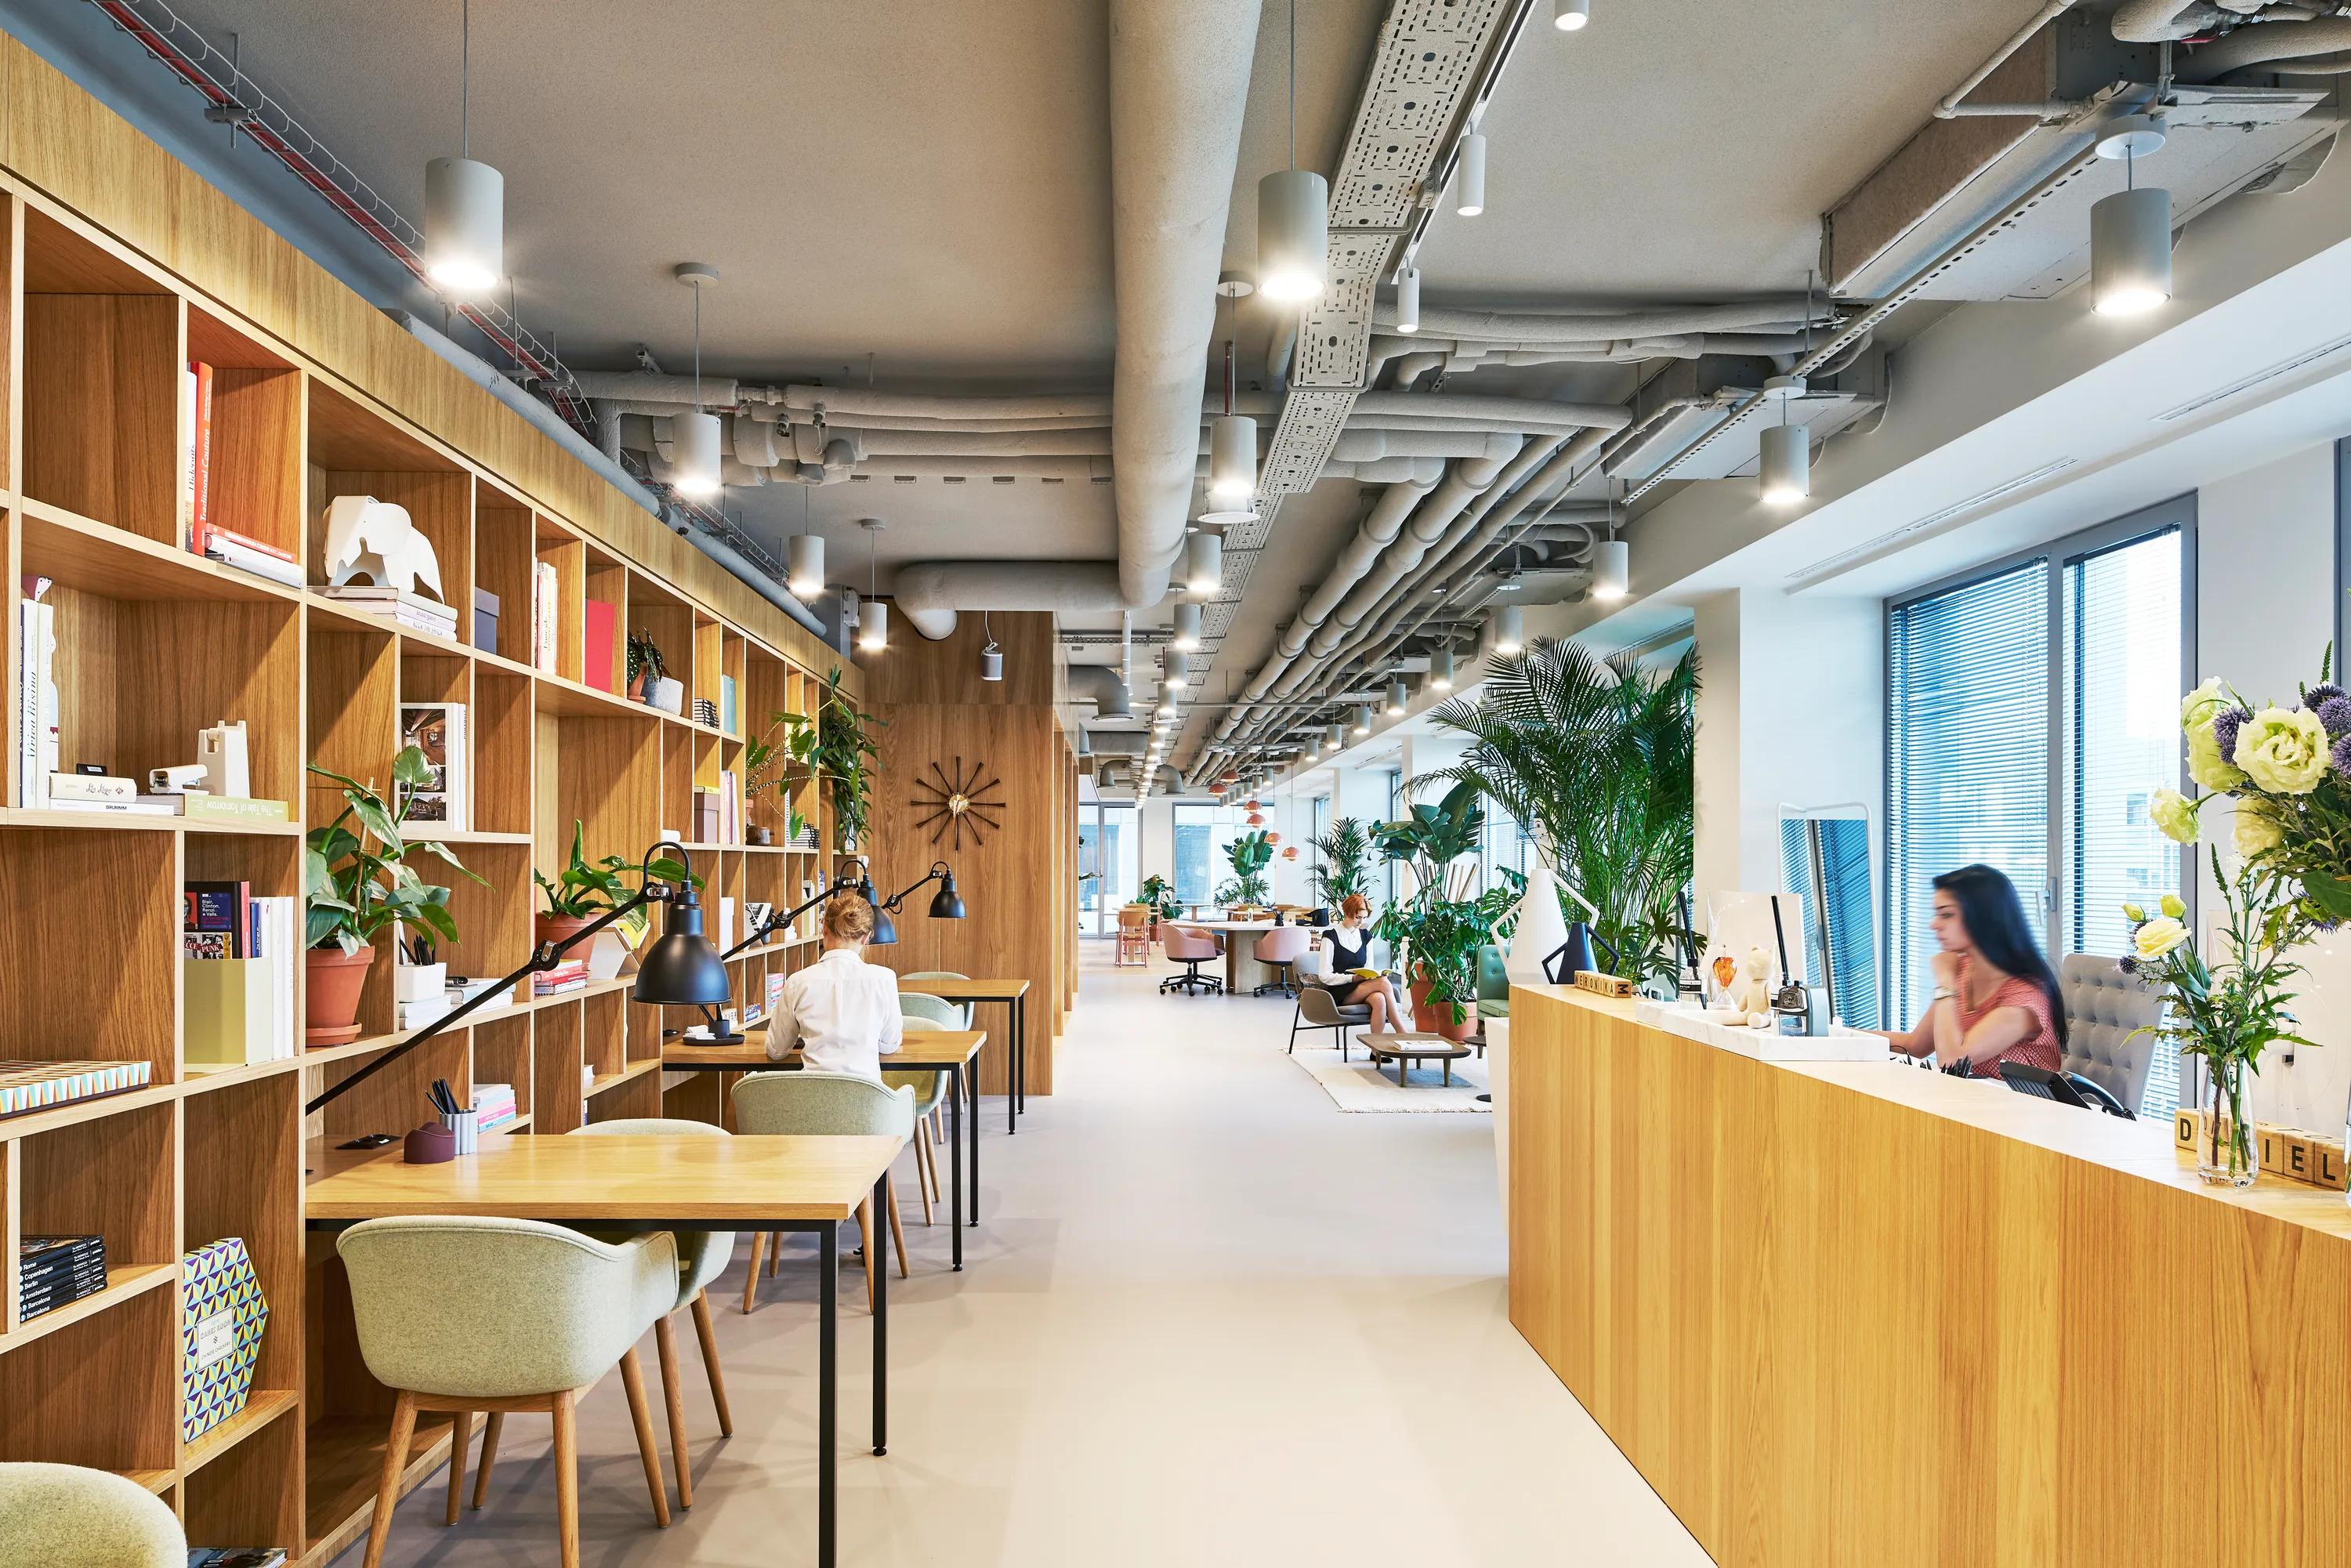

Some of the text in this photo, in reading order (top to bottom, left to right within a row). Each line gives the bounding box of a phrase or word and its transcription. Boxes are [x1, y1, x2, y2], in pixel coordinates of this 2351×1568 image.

[201, 429, 210, 467] Couture
[200, 470, 208, 521] Traditional
[206, 801, 239, 814] Tomorrow
[247, 803, 261, 816] Tale
[261, 804, 273, 816] The
[201, 943, 219, 953] PUNK
[1575, 974, 1614, 994] WERONIKA
[23, 1262, 37, 1271] Rome
[24, 1266, 53, 1280] Copenhagen
[24, 1280, 38, 1291] Berlin
[25, 1286, 53, 1301] Amsterdam
[27, 1296, 51, 1309] Barcelona
[27, 1305, 50, 1320] Barcelona
